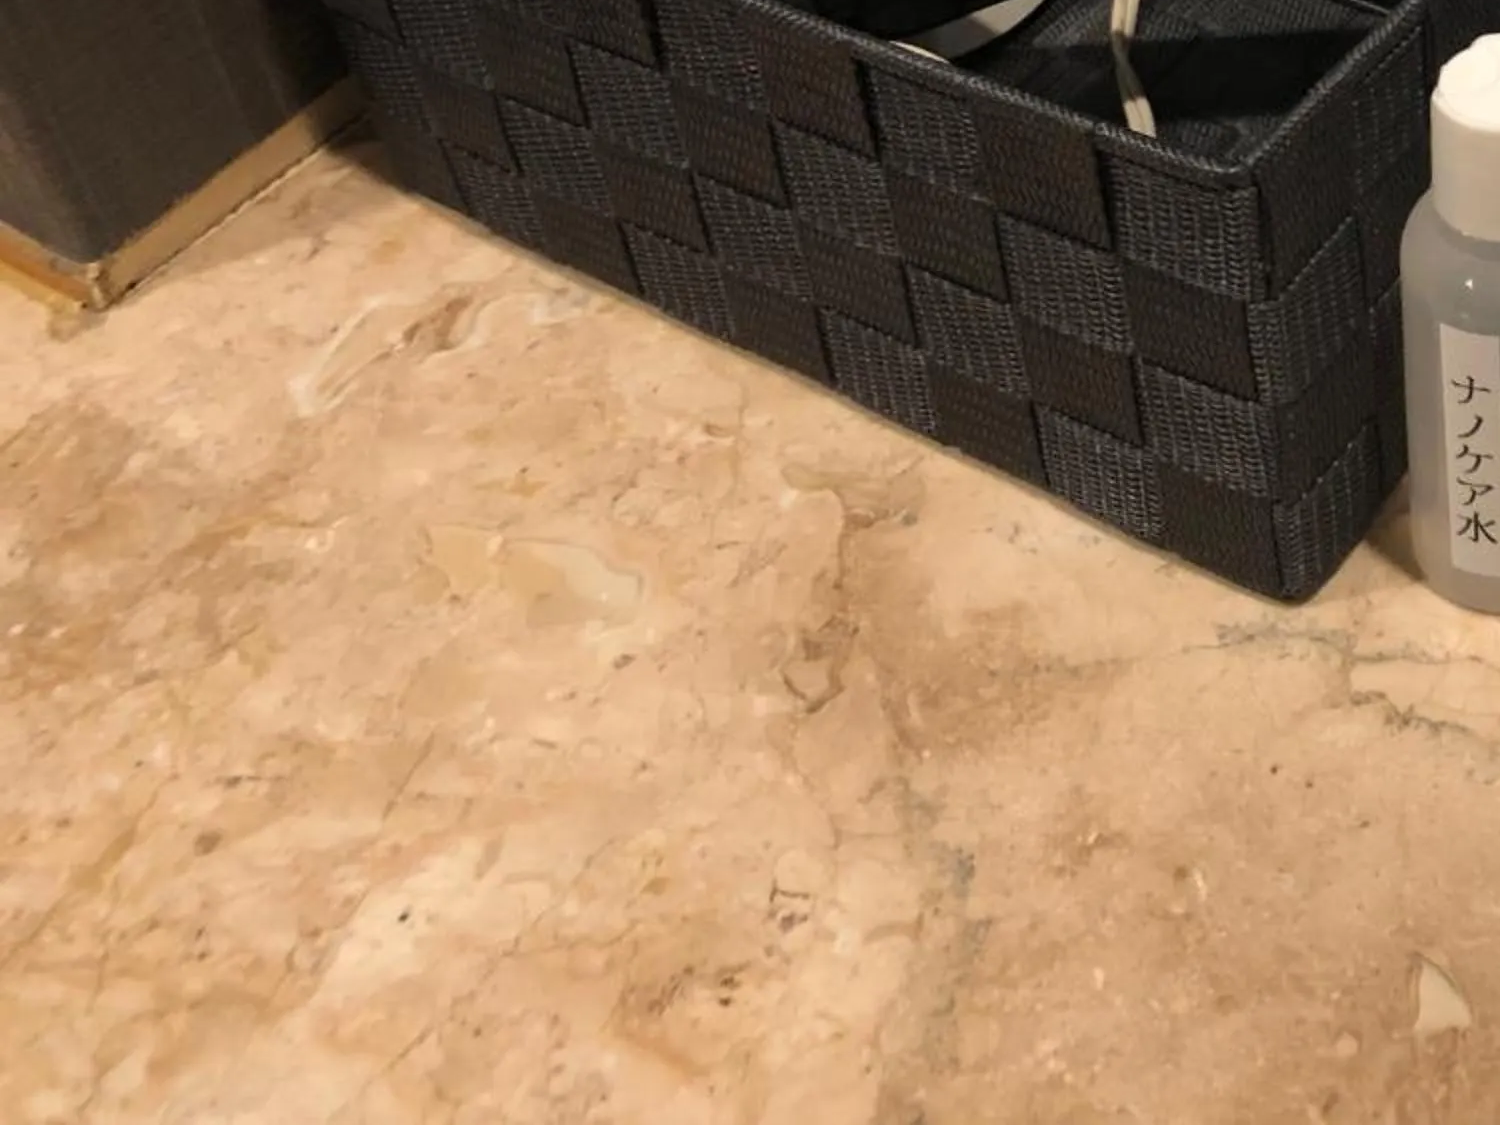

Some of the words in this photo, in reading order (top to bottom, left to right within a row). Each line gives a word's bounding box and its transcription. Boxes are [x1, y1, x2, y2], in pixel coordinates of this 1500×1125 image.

[1451, 375, 1499, 545] ナノケア水
